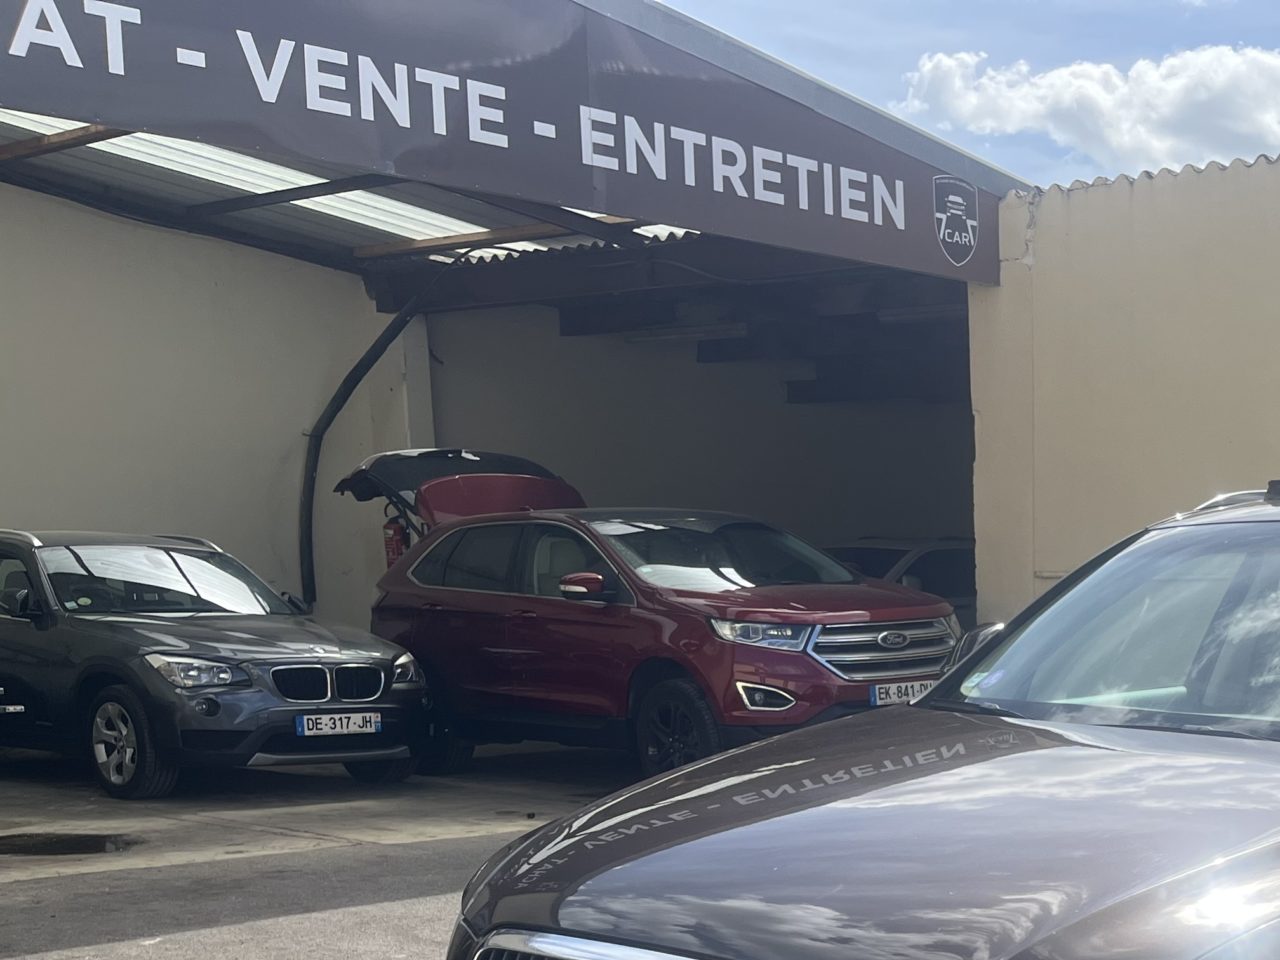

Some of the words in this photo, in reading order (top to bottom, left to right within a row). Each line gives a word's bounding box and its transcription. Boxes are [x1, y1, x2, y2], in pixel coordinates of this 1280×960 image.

[8, 0, 142, 76] AT
[235, 29, 509, 148] VENTE
[579, 104, 905, 230] ENTRETIEN
[306, 716, 373, 732] DE-317-JH
